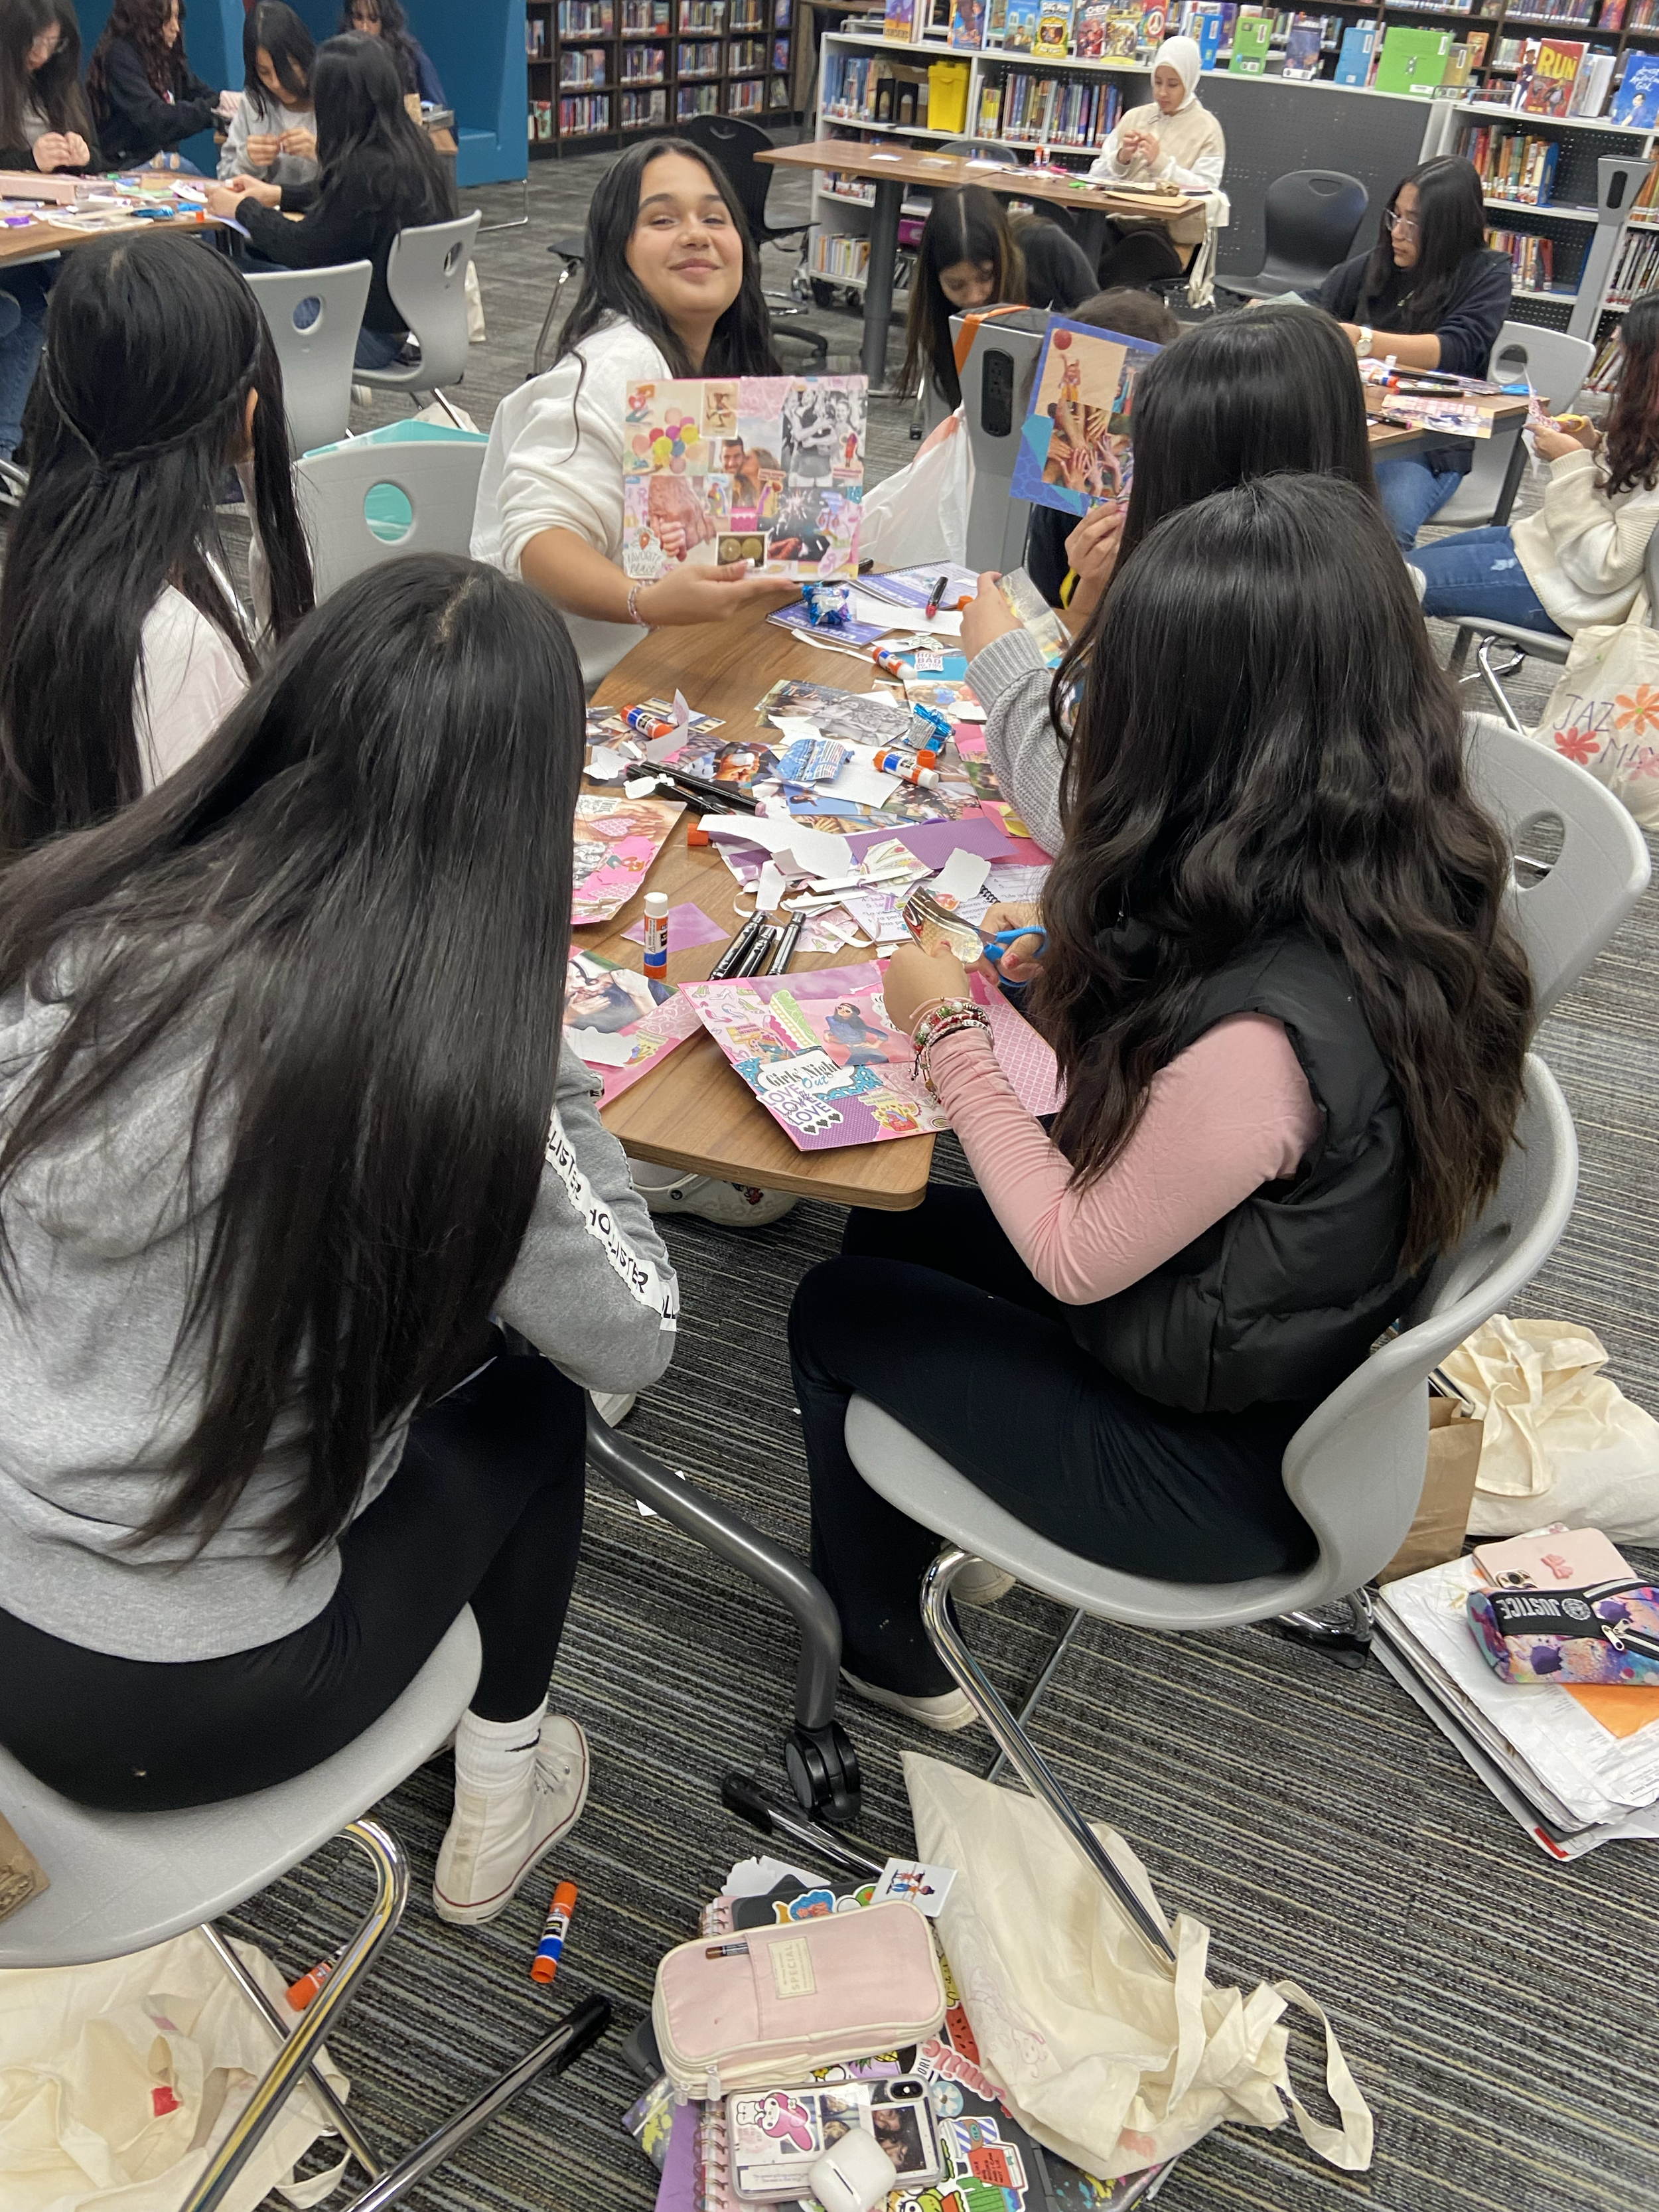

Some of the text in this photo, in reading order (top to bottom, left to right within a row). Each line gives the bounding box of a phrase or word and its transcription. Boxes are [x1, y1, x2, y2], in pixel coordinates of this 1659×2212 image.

[1537, 46, 1577, 81] RUN
[1553, 694, 1615, 732] JAZ
[765, 1068, 804, 1087] Girls'
[802, 1076, 829, 1088] Out
[760, 1083, 802, 1106] LOVE
[782, 1102, 831, 1126] LOVE
[1496, 1597, 1561, 1619] JUSTICE
[784, 1944, 800, 1991] SPECIAL
